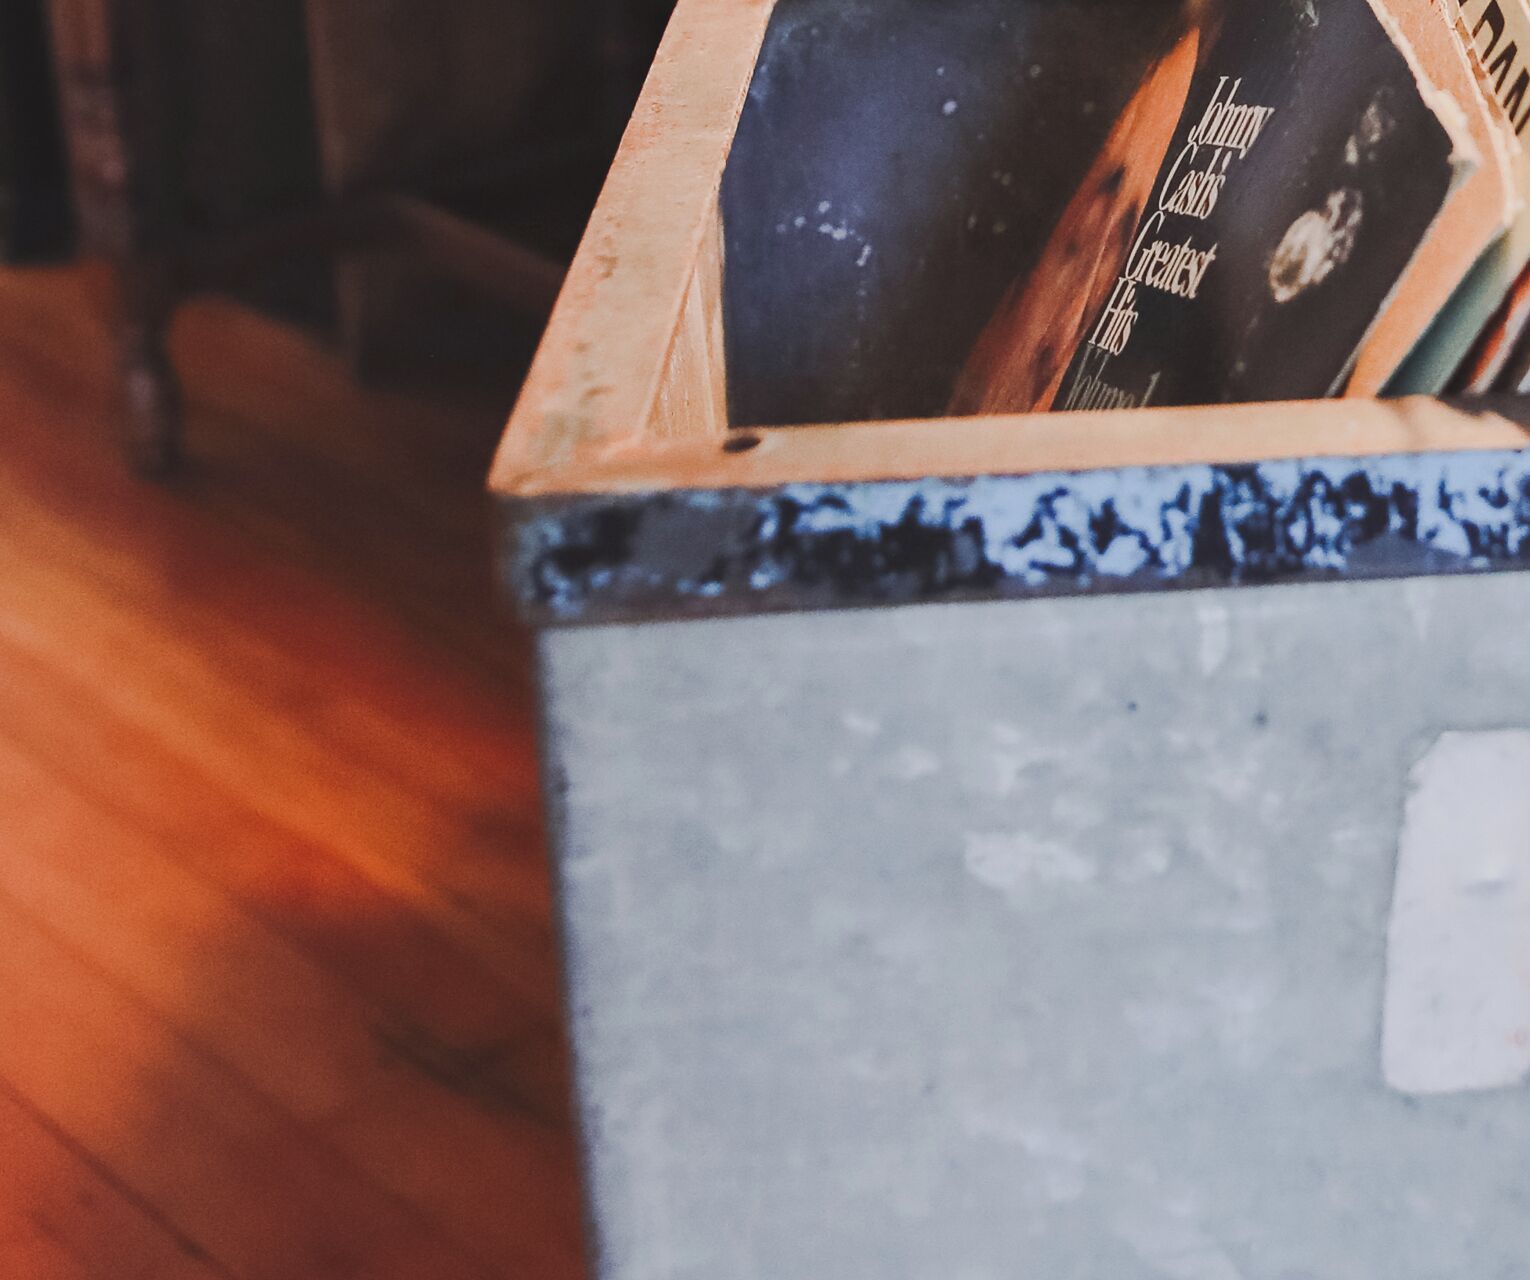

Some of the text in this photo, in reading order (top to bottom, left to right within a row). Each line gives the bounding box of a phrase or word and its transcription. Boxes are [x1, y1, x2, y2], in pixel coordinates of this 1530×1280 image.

[1188, 75, 1274, 160] Johnny
[1159, 142, 1232, 220] Cash's
[1125, 210, 1218, 300] Greatest
[1087, 277, 1138, 356] Hits
